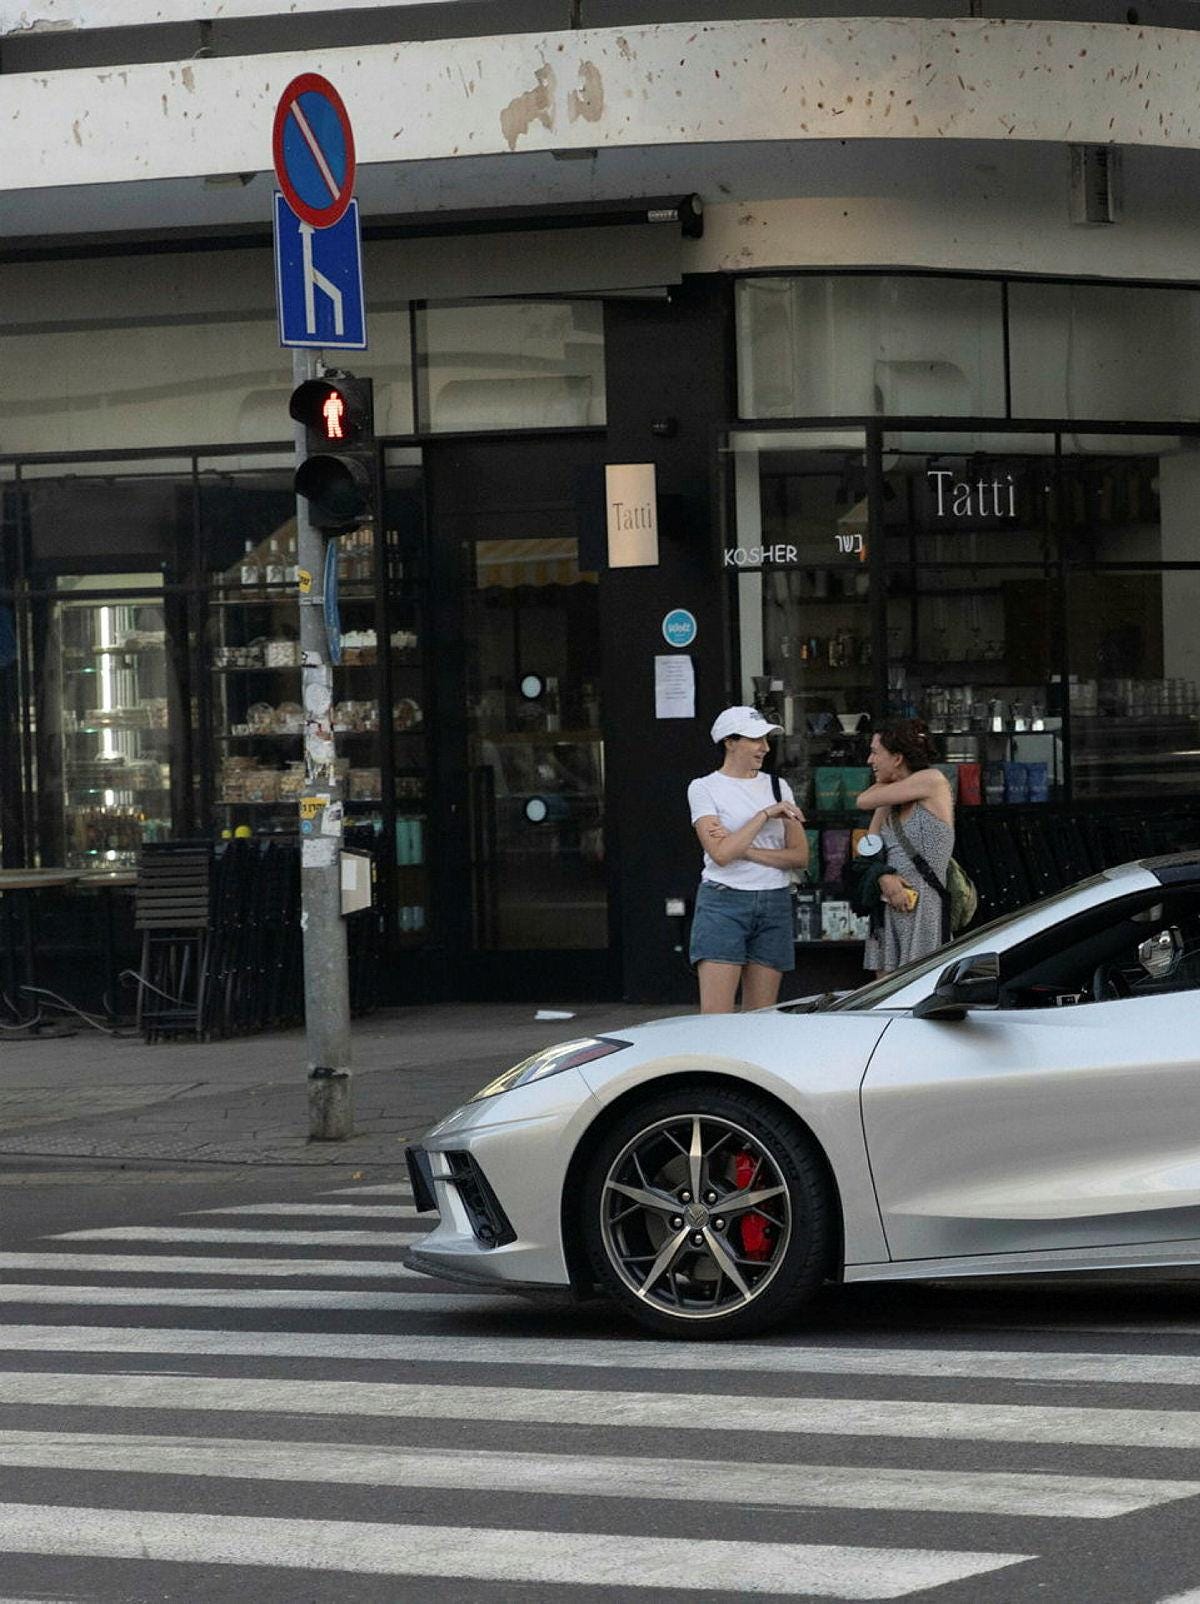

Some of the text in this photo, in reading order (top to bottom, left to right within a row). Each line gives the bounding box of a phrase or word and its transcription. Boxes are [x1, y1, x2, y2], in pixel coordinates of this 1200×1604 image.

[927, 470, 1016, 517] Tatti
[612, 502, 653, 531] Tatti
[723, 544, 798, 567] KOSHER
[834, 534, 863, 553] כשר
